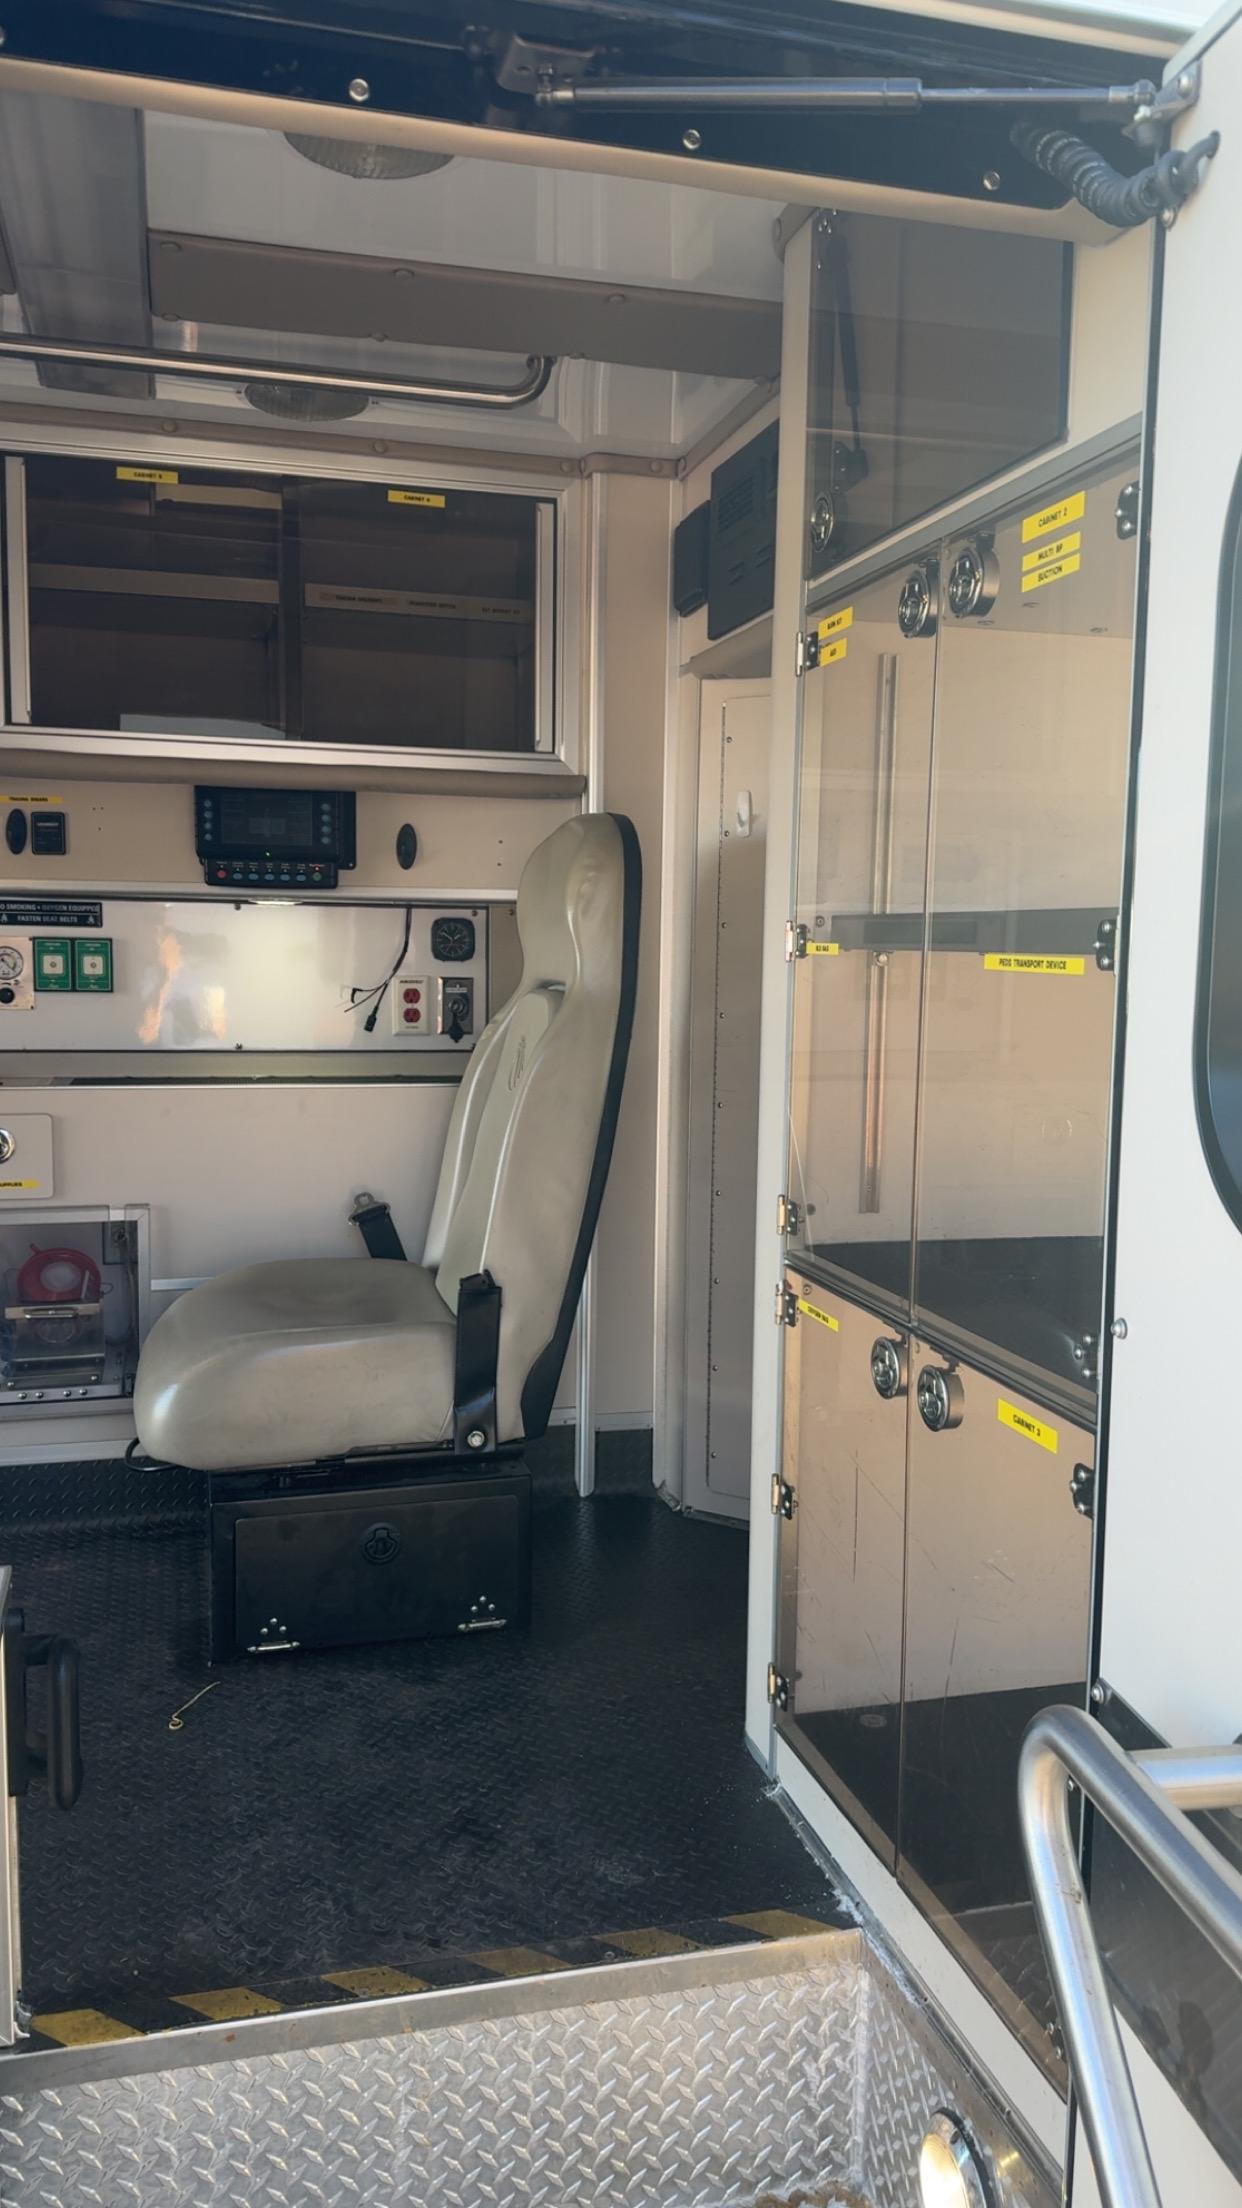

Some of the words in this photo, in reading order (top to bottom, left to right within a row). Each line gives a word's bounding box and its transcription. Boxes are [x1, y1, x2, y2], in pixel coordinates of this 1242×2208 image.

[1038, 509, 1062, 528] CABINET
[1063, 506, 1068, 517] 2
[1038, 546, 1054, 561] MULTI
[1038, 564, 1063, 582] SUCTION
[7, 903, 36, 911] SMOKING
[68, 904, 99, 912] EQUIPPED
[999, 958, 1012, 967] PEDS
[1013, 958, 1044, 969] TRANSPORT
[1045, 960, 1067, 970] DEVICE
[1013, 1414, 1036, 1433] CABINET
